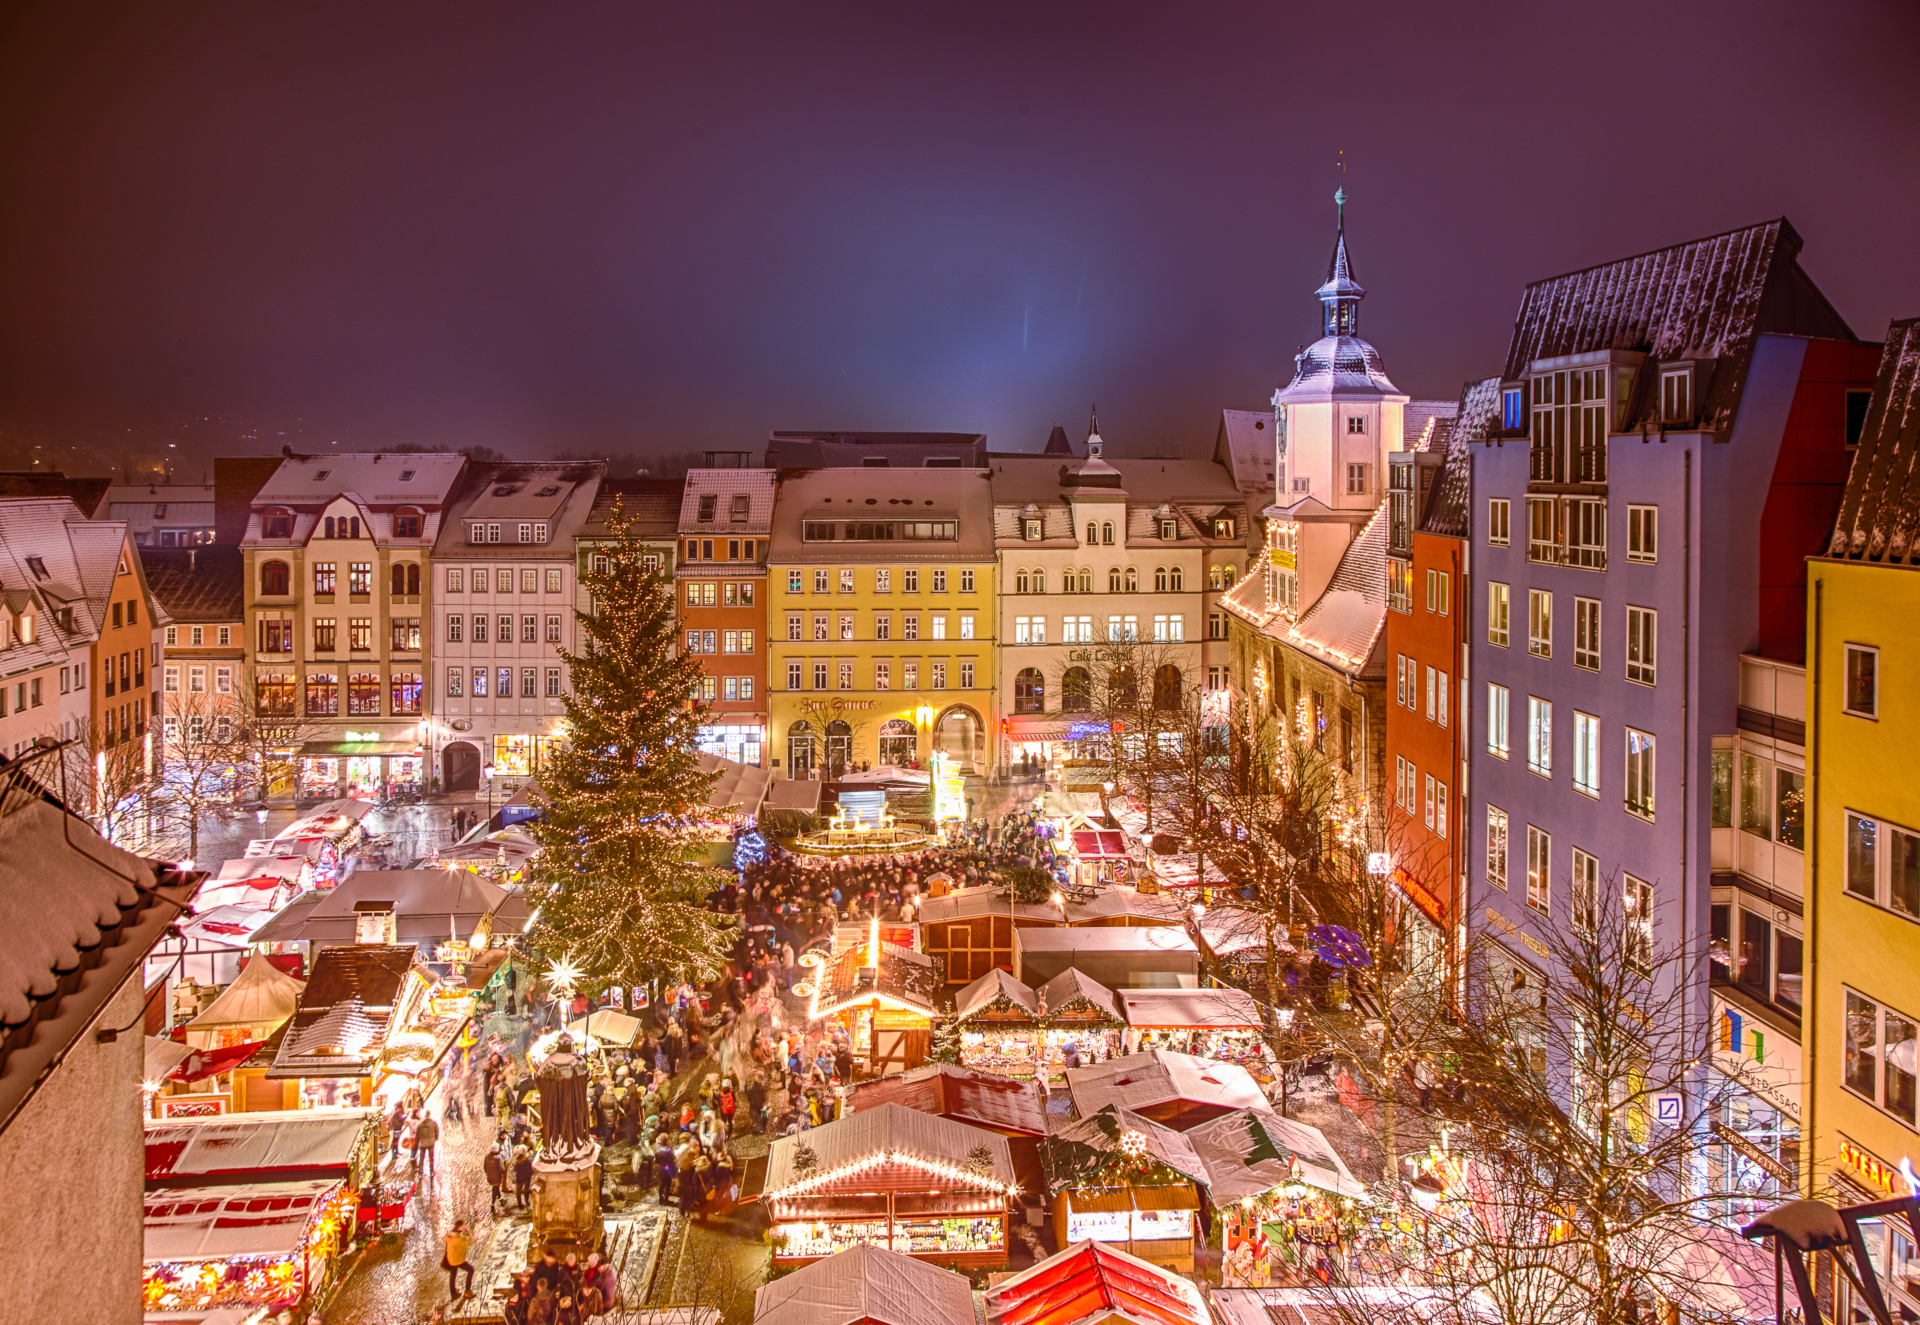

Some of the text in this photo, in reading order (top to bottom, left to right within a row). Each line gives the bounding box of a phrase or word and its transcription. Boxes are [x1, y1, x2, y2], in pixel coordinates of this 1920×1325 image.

[800, 697, 877, 714] Zur Sonne
[1520, 930, 1550, 961] FRISEUR
[1839, 1140, 1894, 1194] STEAK
